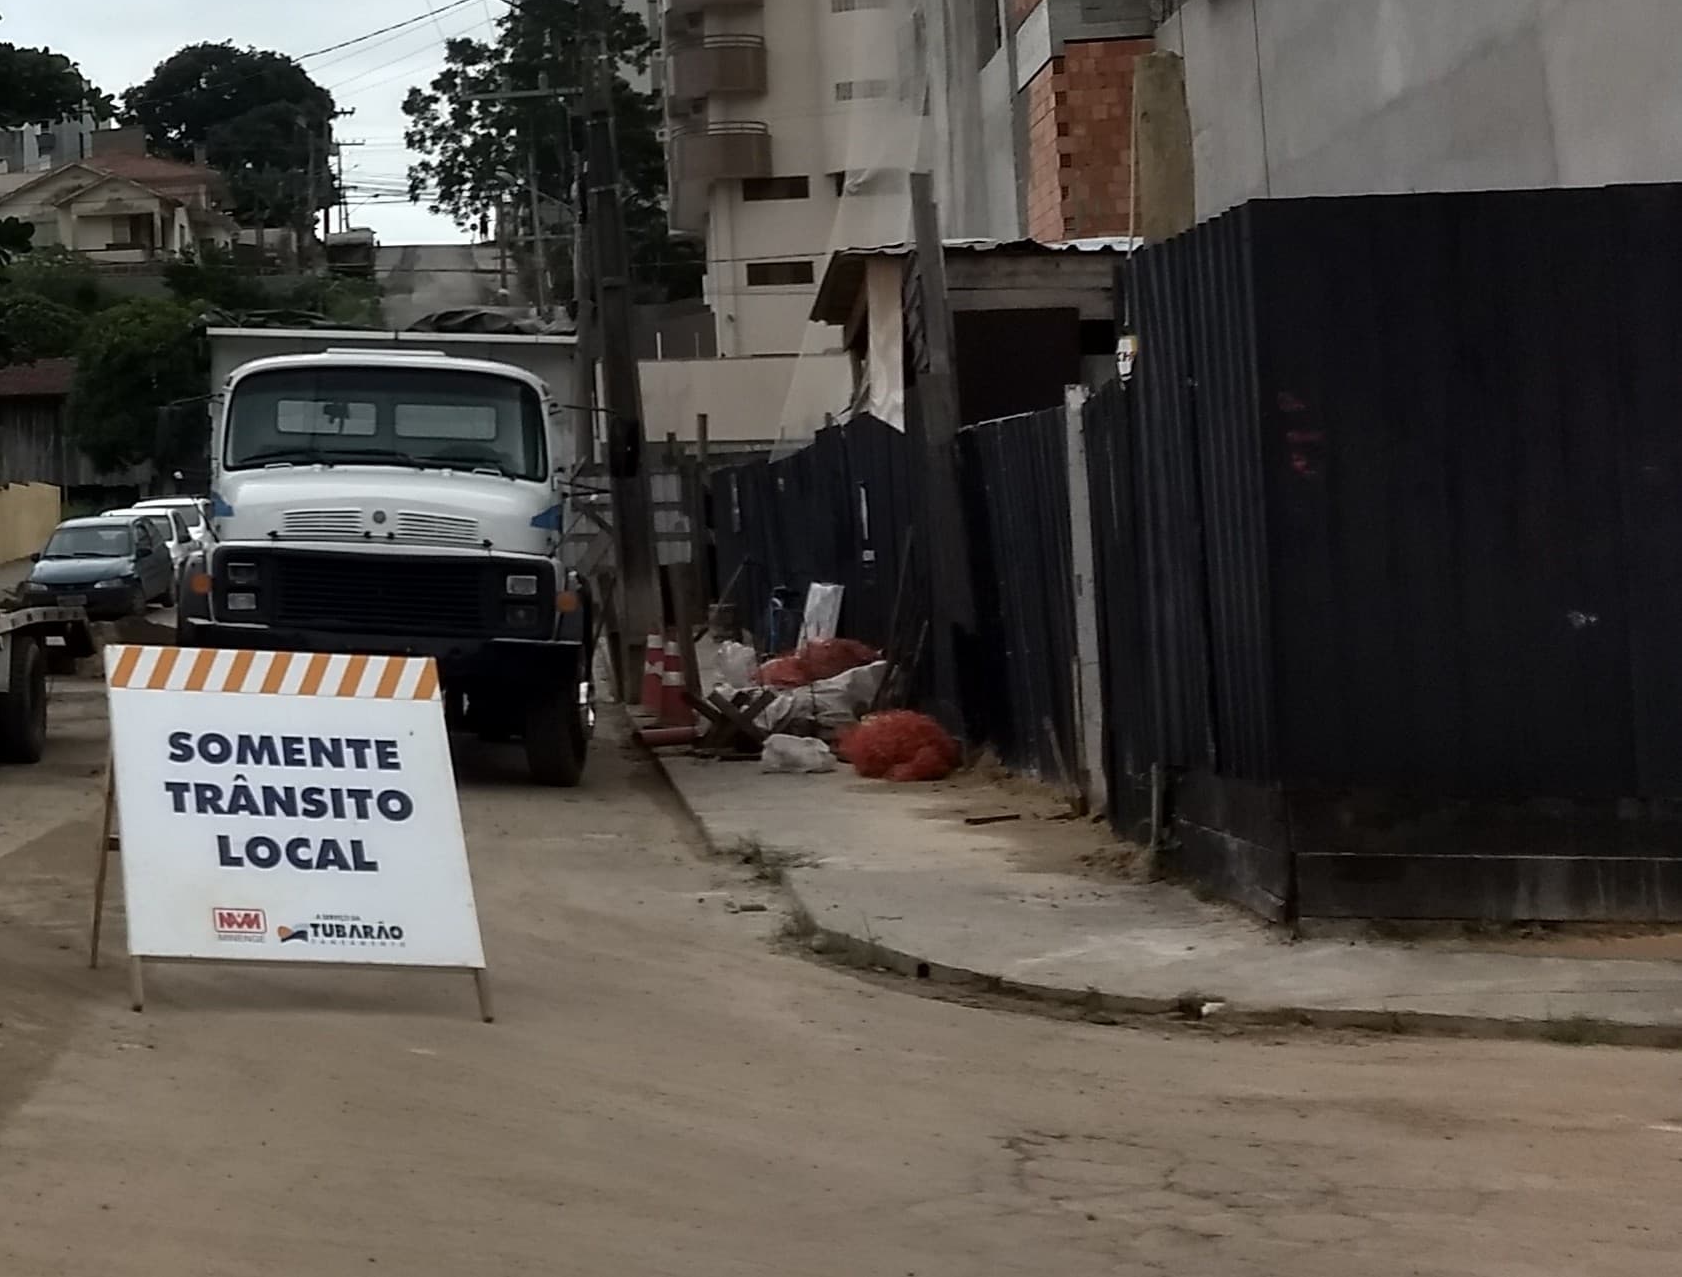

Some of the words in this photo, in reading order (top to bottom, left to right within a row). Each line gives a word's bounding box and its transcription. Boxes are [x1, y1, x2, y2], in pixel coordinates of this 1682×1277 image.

[167, 731, 402, 771] SOMENTE
[164, 774, 414, 822] TRÂNSITO
[217, 835, 380, 872] LOCAL
[310, 920, 404, 940] TUBARÃO
